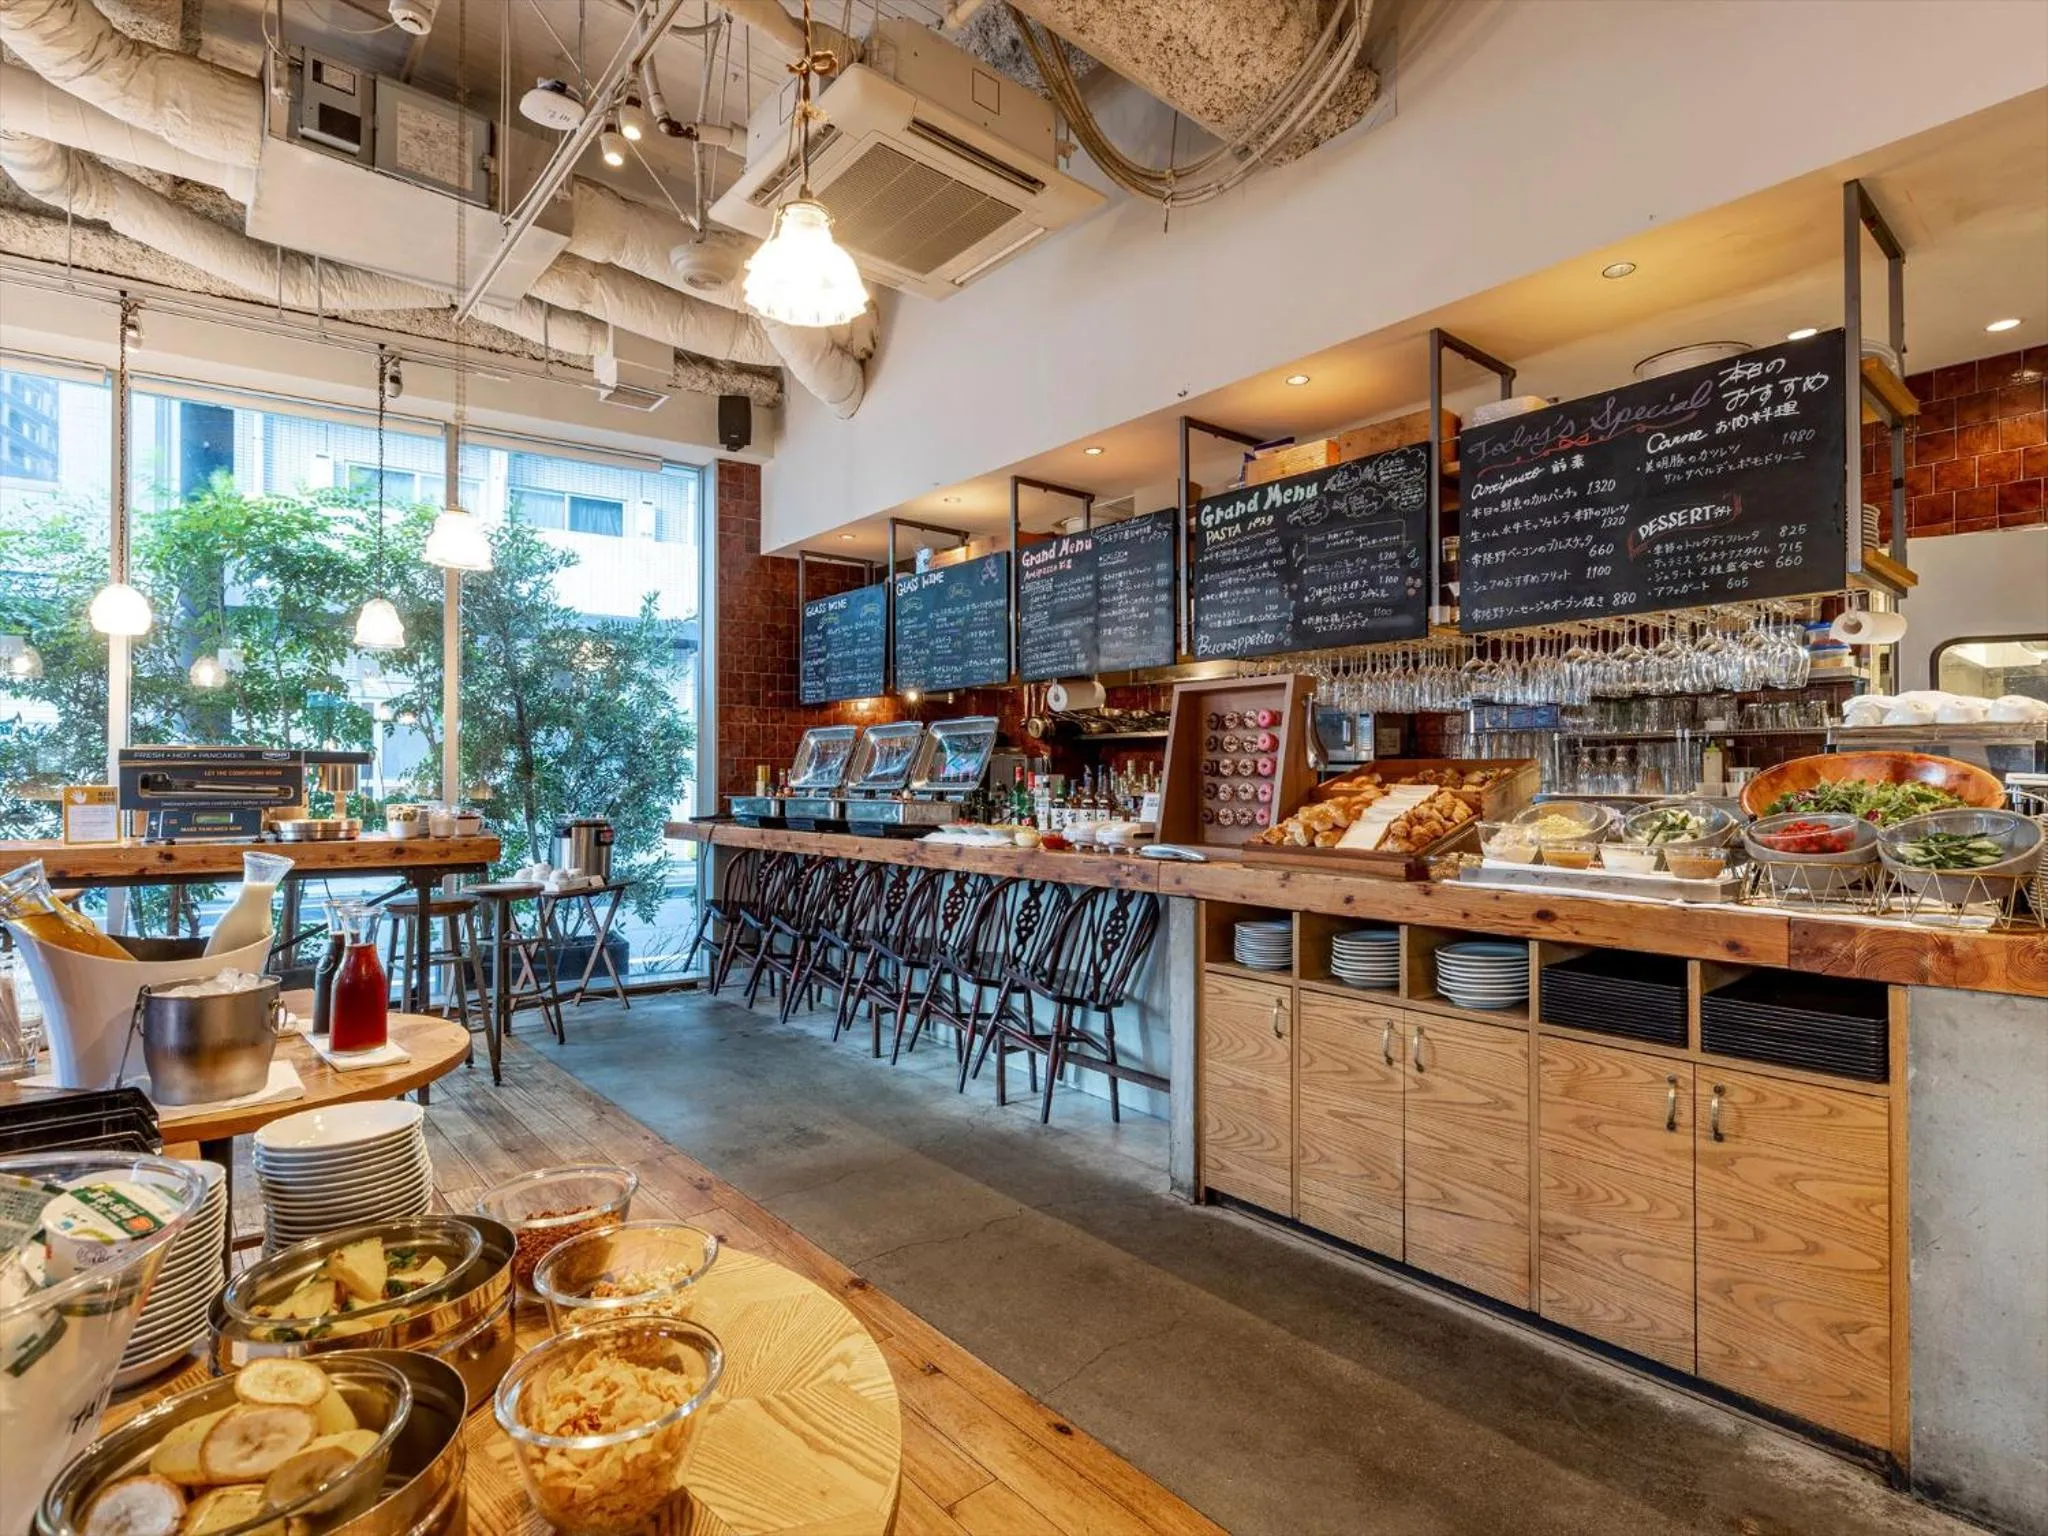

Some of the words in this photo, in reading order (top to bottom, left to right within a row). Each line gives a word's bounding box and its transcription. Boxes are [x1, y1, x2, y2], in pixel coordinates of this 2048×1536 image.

[1718, 358, 1787, 388] 本日の
[1722, 372, 1829, 411] おすすめ
[1467, 415, 1576, 463] Today's
[1584, 379, 1713, 439] Special
[1201, 491, 1259, 528] Grand
[1262, 482, 1318, 509] Menu
[1638, 504, 1715, 540] DESSERT
[1779, 523, 1807, 538] 825
[1206, 523, 1241, 546] PASTA
[1022, 540, 1057, 567] Grand
[1058, 537, 1093, 557] Menu
[1589, 543, 1614, 557] 660
[1778, 542, 1803, 554] 715
[1776, 555, 1803, 568] 660
[896, 577, 919, 597] GLASS
[922, 571, 945, 588] WINE
[806, 602, 827, 617] GLASS
[828, 598, 847, 611] WINE
[1612, 591, 1636, 607] 880
